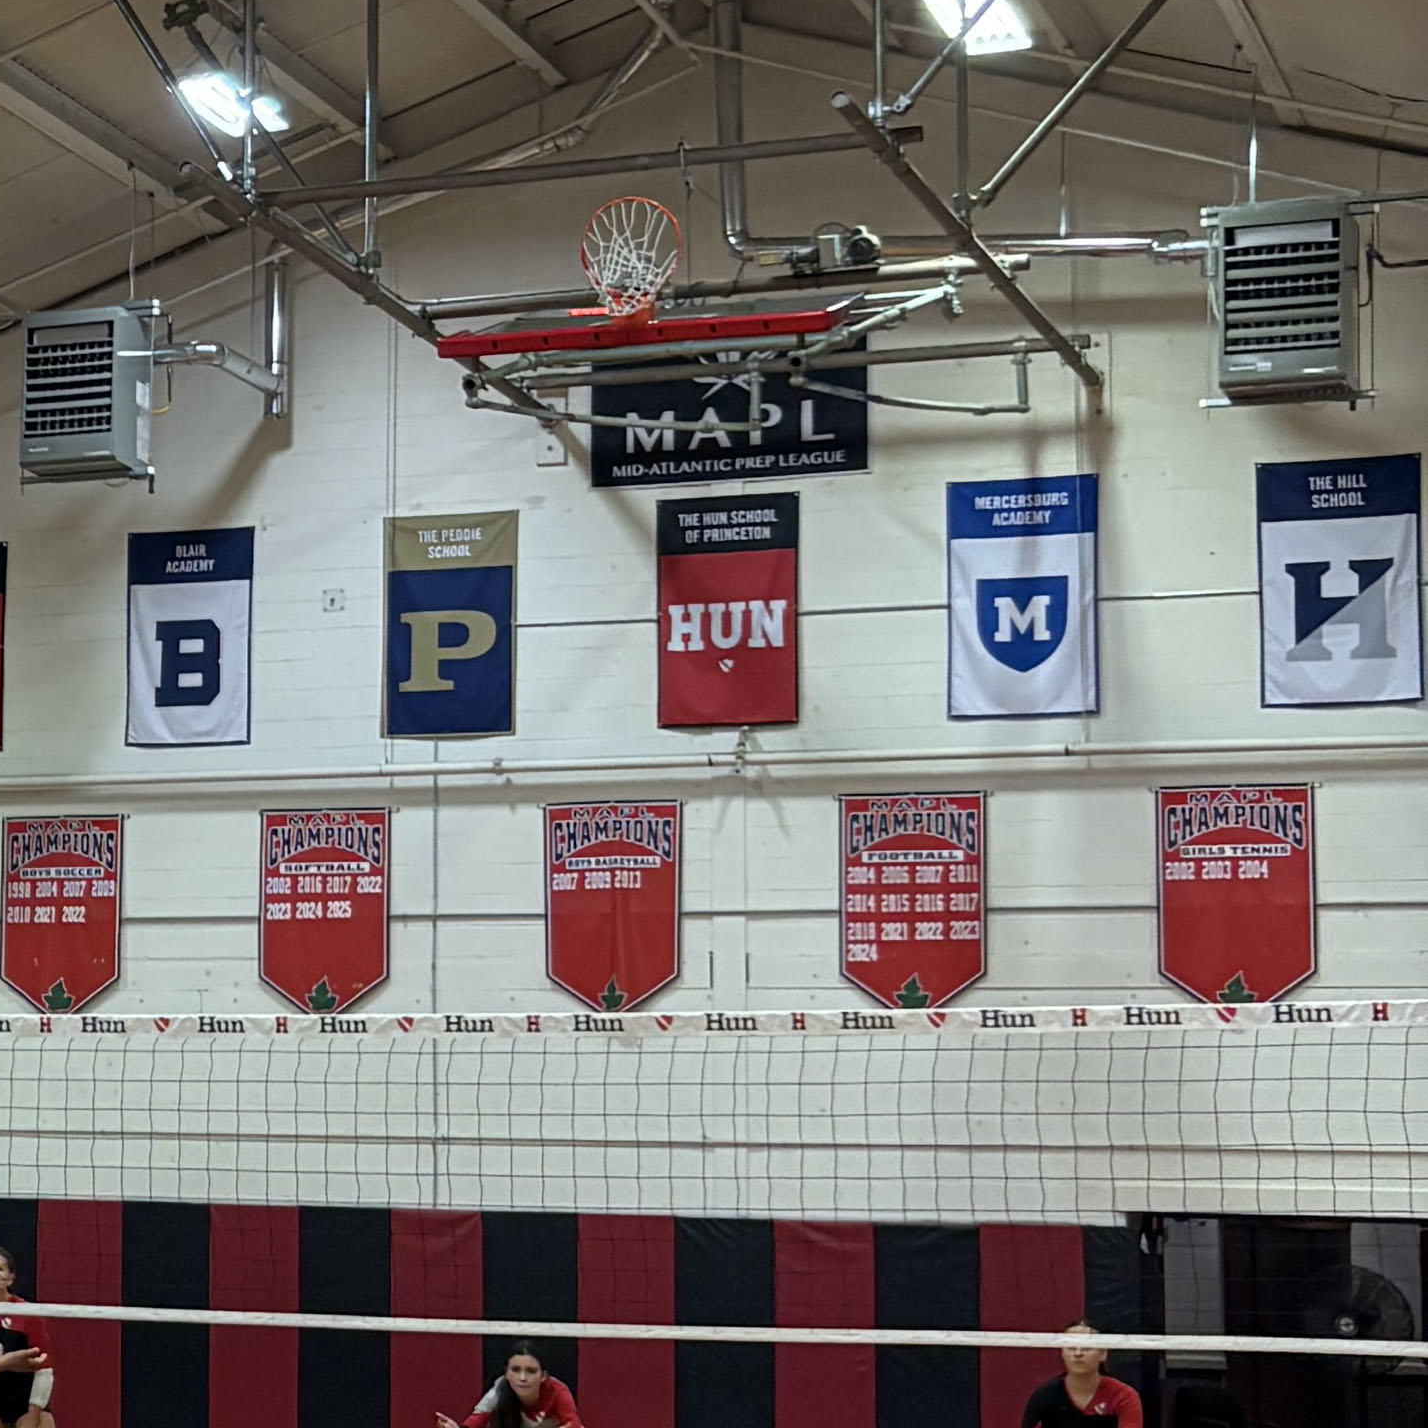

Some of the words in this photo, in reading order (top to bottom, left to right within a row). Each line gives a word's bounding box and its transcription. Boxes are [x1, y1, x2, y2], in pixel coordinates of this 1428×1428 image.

[625, 400, 836, 454] MAPL
[612, 458, 732, 477] MID-ATLANTIC
[735, 455, 776, 470] PREP
[779, 450, 846, 466] LEAGUE
[1308, 476, 1333, 490] THE
[1337, 474, 1367, 489] HILL
[974, 492, 1069, 510] MERCERSBURG
[1311, 492, 1365, 509] SCHOOL
[678, 514, 701, 527] THE
[702, 512, 728, 526] HUN
[730, 509, 779, 523] SCHOOL
[992, 510, 1052, 526] ACADEMY
[418, 530, 438, 543] THE
[441, 528, 482, 542] PEDDIE
[685, 530, 702, 544] OF
[703, 526, 771, 542] PRINCETON
[175, 544, 206, 557] BLAIR
[428, 545, 472, 558] SCHOOL
[165, 559, 215, 573] ACADEMY
[994, 595, 1051, 642] M
[1285, 557, 1397, 662] H
[667, 600, 787, 652] HUN
[399, 610, 496, 692] P
[155, 619, 220, 707] B
[848, 810, 978, 858] CHAMPIONS
[1165, 802, 1305, 852] CHAMPIONS
[267, 824, 383, 869] CHAMPIONS
[552, 817, 674, 864] CHAMPIONS
[9, 830, 116, 873] CHAMPIONS
[867, 851, 959, 861] FOOTBALL
[1181, 846, 1226, 856] GIRLS
[1229, 846, 1289, 855] TENNIS
[22, 868, 51, 876] BOYS
[55, 868, 102, 876] SOCCER
[284, 863, 366, 872] SOFTBALL
[567, 859, 592, 868] BOYS
[594, 858, 658, 866] BASKETBALL
[1238, 860, 1269, 879] 2004
[552, 873, 578, 891] 2007
[614, 870, 641, 888] 2013
[949, 864, 978, 883] 2011
[297, 876, 322, 894] 2016
[326, 876, 352, 894] 2017
[356, 876, 383, 893] 2022
[266, 903, 291, 920] 2023
[295, 902, 323, 919] 2024
[326, 901, 352, 918] 2025
[847, 894, 876, 913] 2014
[880, 893, 910, 912] 2015
[949, 893, 979, 912] 2017
[7, 906, 31, 923] 2010
[34, 906, 56, 923] 2021
[62, 906, 86, 923] 2022
[880, 922, 909, 941] 2021
[915, 922, 944, 940] 2022
[949, 921, 980, 940] 2023
[847, 943, 878, 962] 2024
[39, 1017, 52, 1033] H
[80, 1016, 126, 1033] Hun
[197, 1016, 245, 1033] Hun
[275, 1016, 289, 1034] H
[319, 1016, 368, 1033] Hun
[443, 1015, 494, 1032] Hun
[526, 1015, 541, 1032] H
[572, 1014, 624, 1032] Hun
[704, 1013, 758, 1031] Hun
[790, 1012, 806, 1031] H
[840, 1011, 894, 1029] Hun
[979, 1009, 1036, 1028] Hun
[1071, 1008, 1088, 1027] H
[1123, 1006, 1182, 1025] Hun
[1272, 1004, 1333, 1023] Hun
[1372, 1003, 1389, 1021] H
